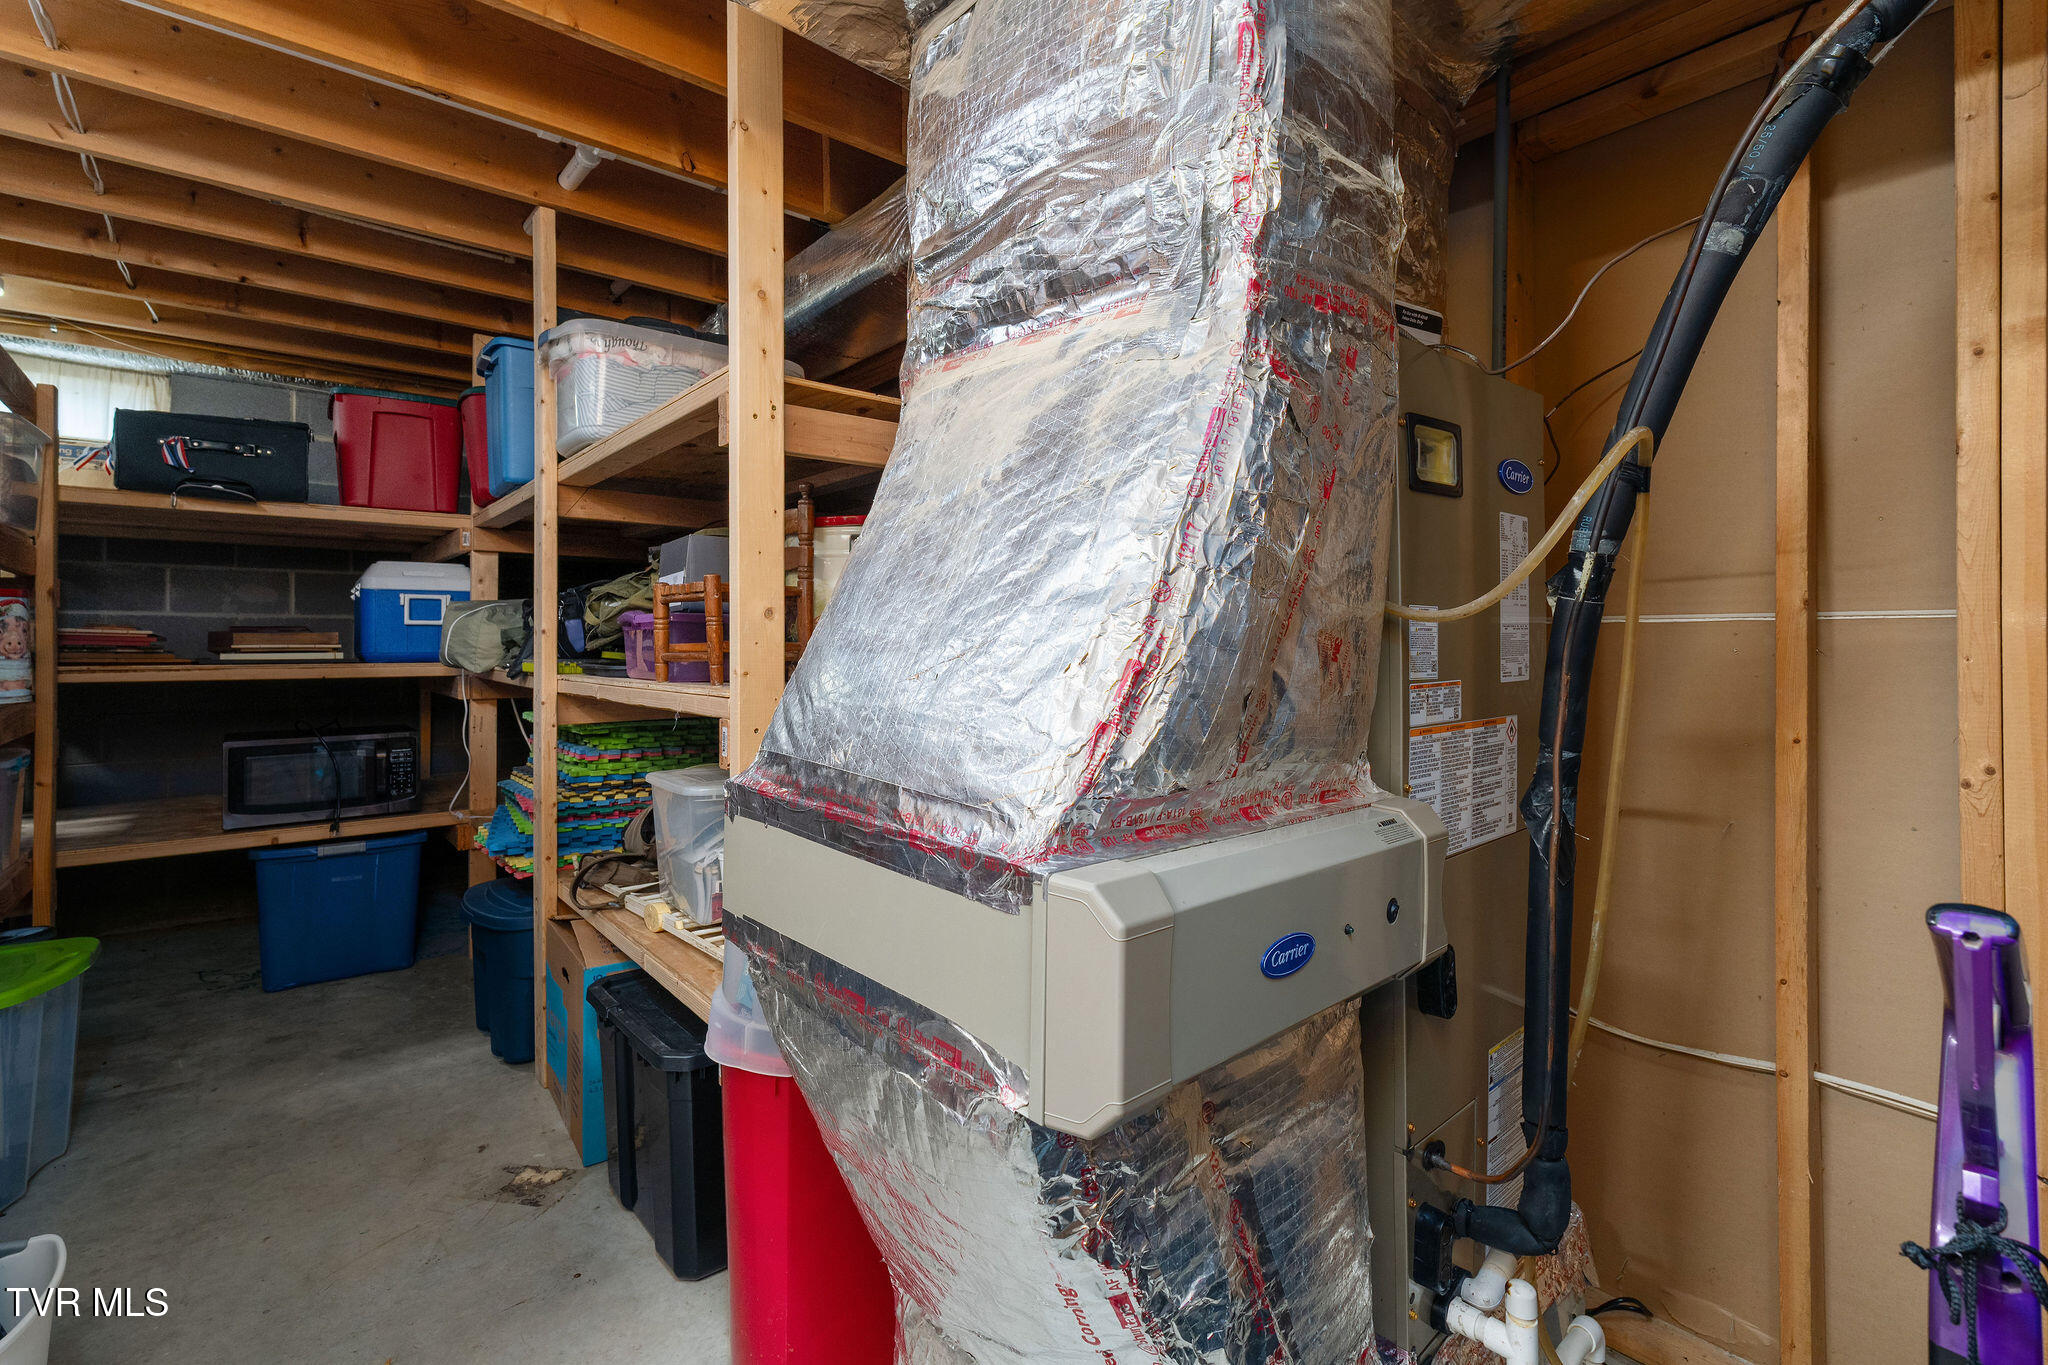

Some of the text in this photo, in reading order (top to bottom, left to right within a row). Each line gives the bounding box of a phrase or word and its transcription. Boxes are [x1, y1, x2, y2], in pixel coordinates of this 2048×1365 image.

[1750, 125, 1776, 158] 25/50
[1506, 466, 1529, 484] Carrier
[1108, 811, 1147, 830] 181B-FX
[1272, 943, 1309, 967] Carrier
[1060, 1287, 1101, 1346] Corning
